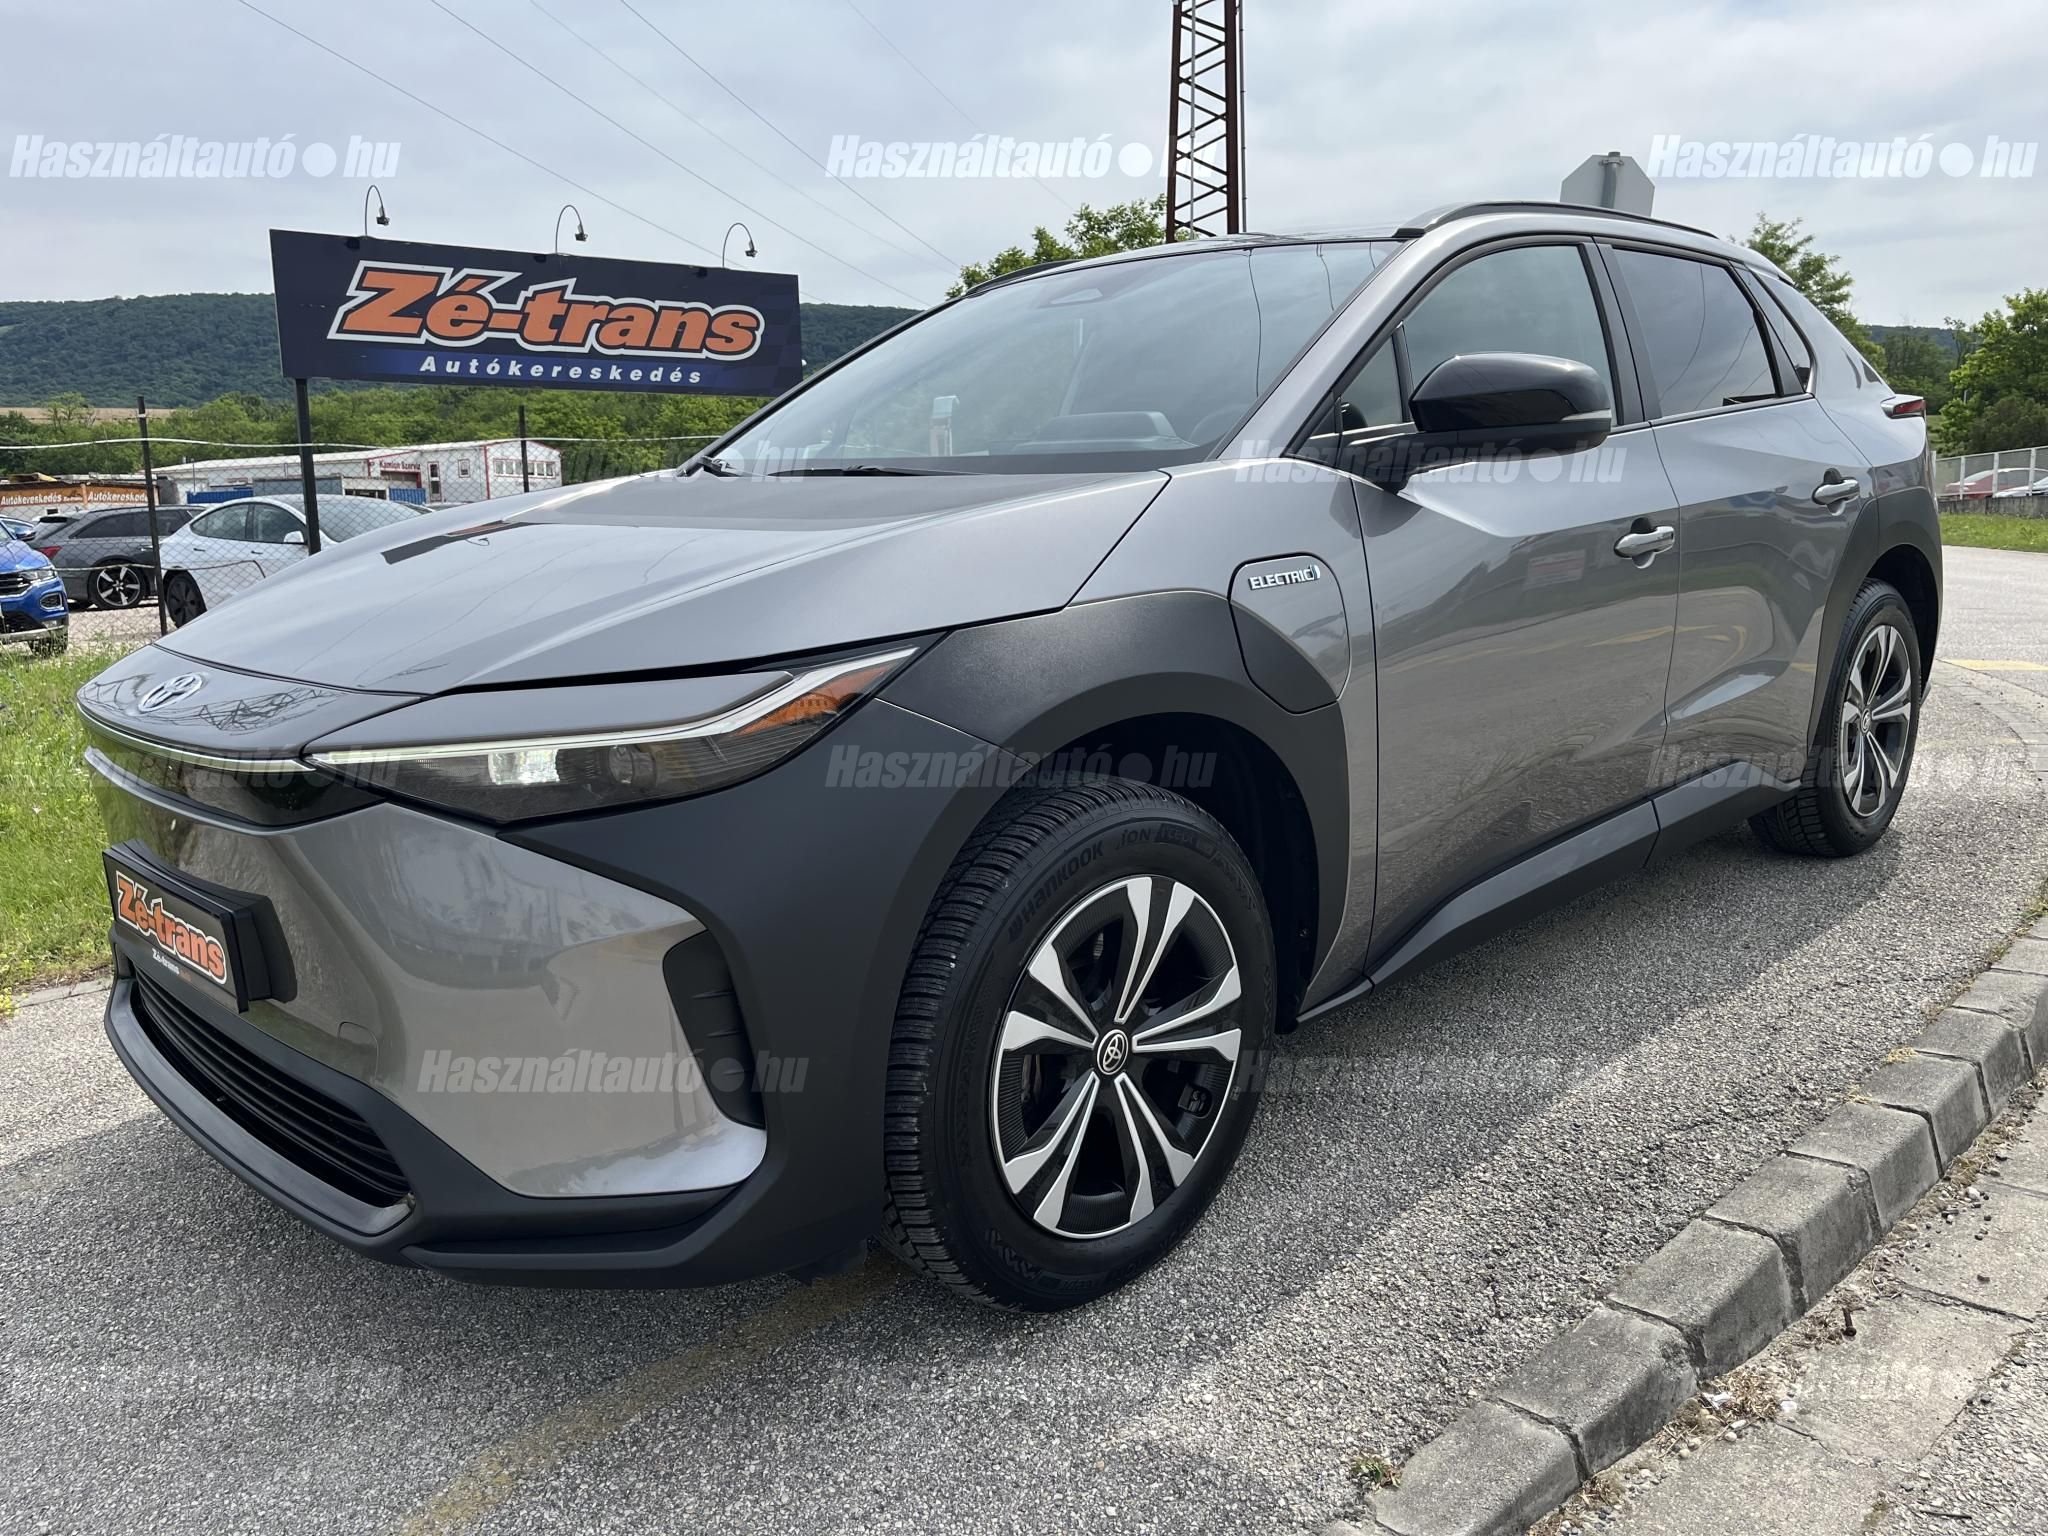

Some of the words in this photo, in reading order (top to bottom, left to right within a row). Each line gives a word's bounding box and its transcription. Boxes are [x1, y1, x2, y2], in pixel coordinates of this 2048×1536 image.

[331, 261, 763, 359] Zé-trans
[420, 354, 703, 383] Autókereskedés
[1249, 566, 1315, 591] ELECTRIC
[116, 871, 227, 984] Zé-trans
